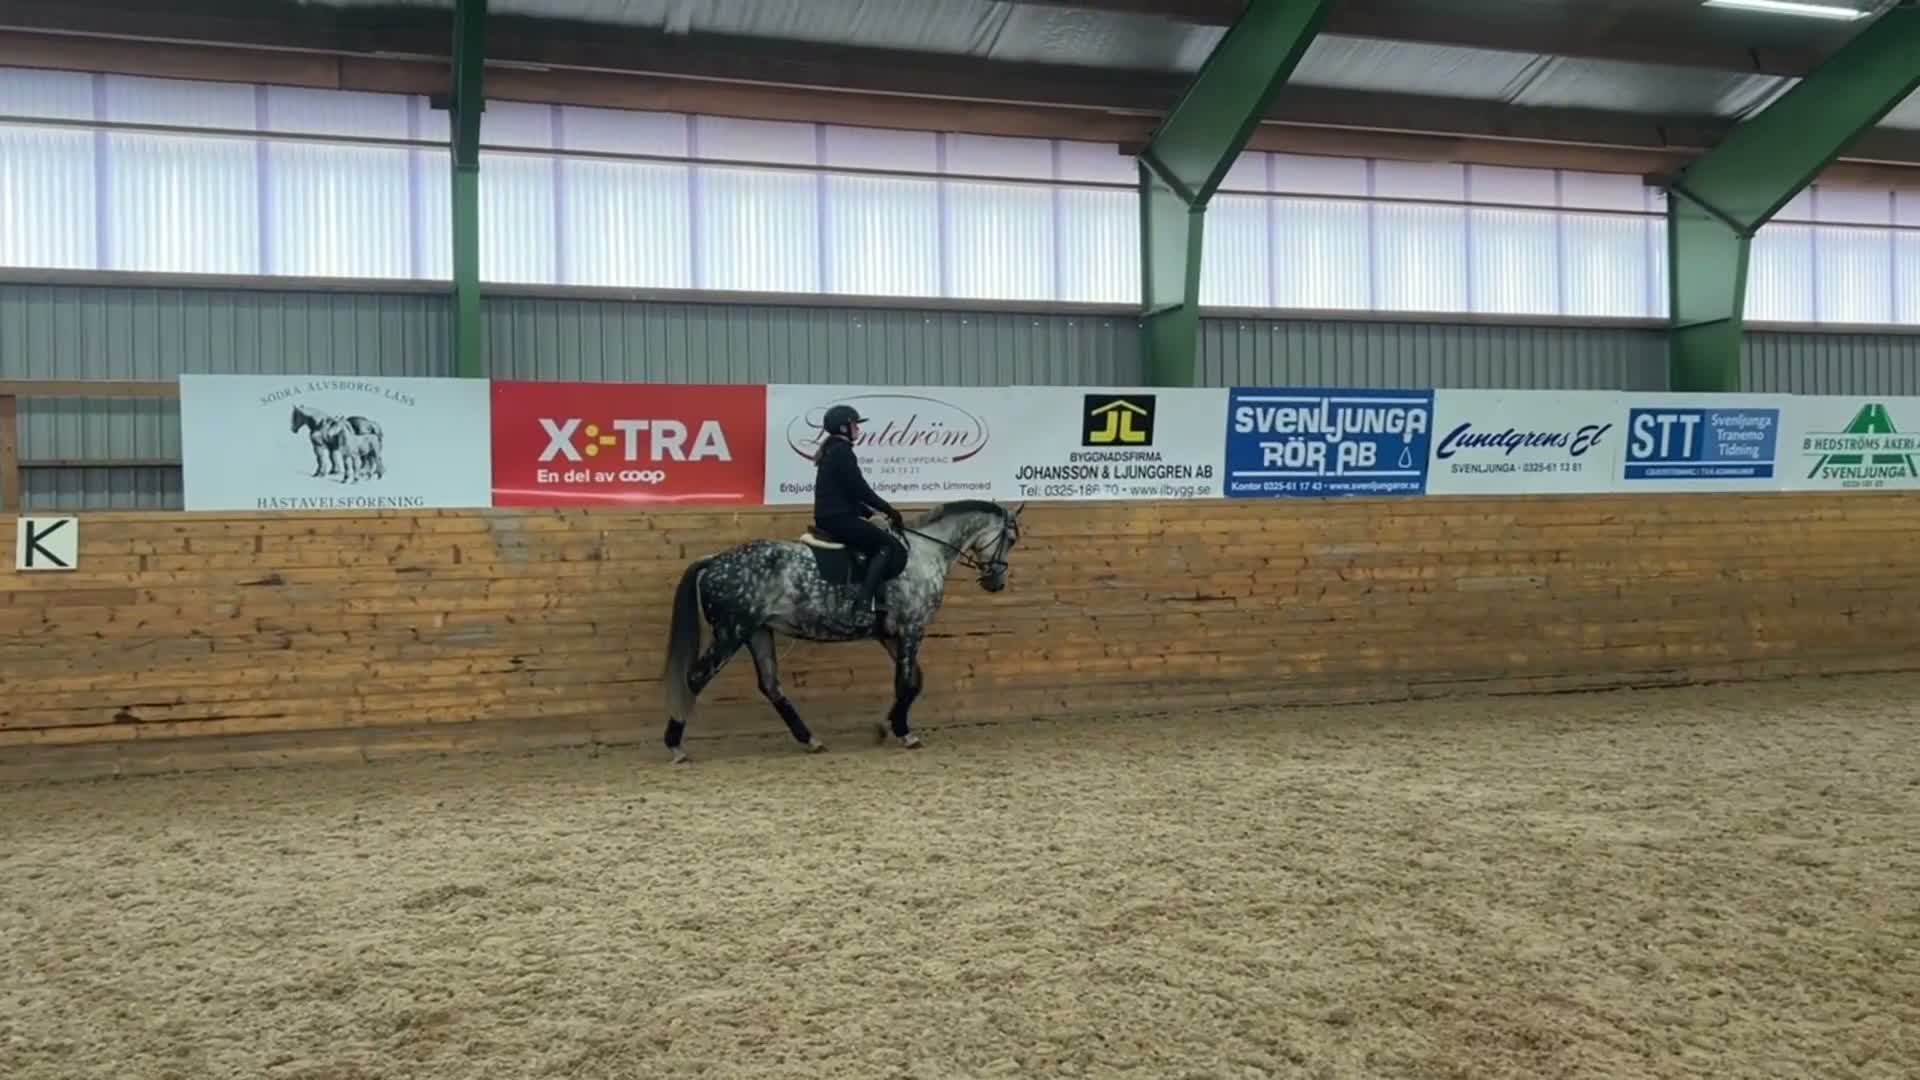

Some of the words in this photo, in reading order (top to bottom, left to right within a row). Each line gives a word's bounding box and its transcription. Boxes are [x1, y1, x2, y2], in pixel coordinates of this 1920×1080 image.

[1711, 413, 1772, 430] Svenljunga
[1437, 422, 1570, 459] Lundgrens
[1569, 423, 1613, 456] El
[1631, 414, 1701, 458] STT
[1716, 429, 1765, 441] Tranemo
[1069, 451, 1162, 463] BYGGNADSFIRMA
[1259, 437, 1327, 475] RÖR
[1336, 441, 1377, 475] AB
[1719, 443, 1760, 459] Tidning
[1015, 465, 1098, 481] JOHANSSON
[1101, 466, 1110, 480] &
[1114, 464, 1192, 480] LJUNGGREN
[1195, 464, 1213, 479] AB
[1451, 463, 1516, 474] SVENLJUNGA
[1822, 465, 1906, 479] SVENLJUNGA
[537, 469, 559, 483] En
[564, 469, 590, 483] del
[594, 472, 615, 483] av
[619, 469, 666, 485] coop
[921, 481, 941, 490] och
[1019, 485, 1040, 496] Tel:
[1231, 482, 1261, 491] Kontor
[25, 519, 69, 567] K
